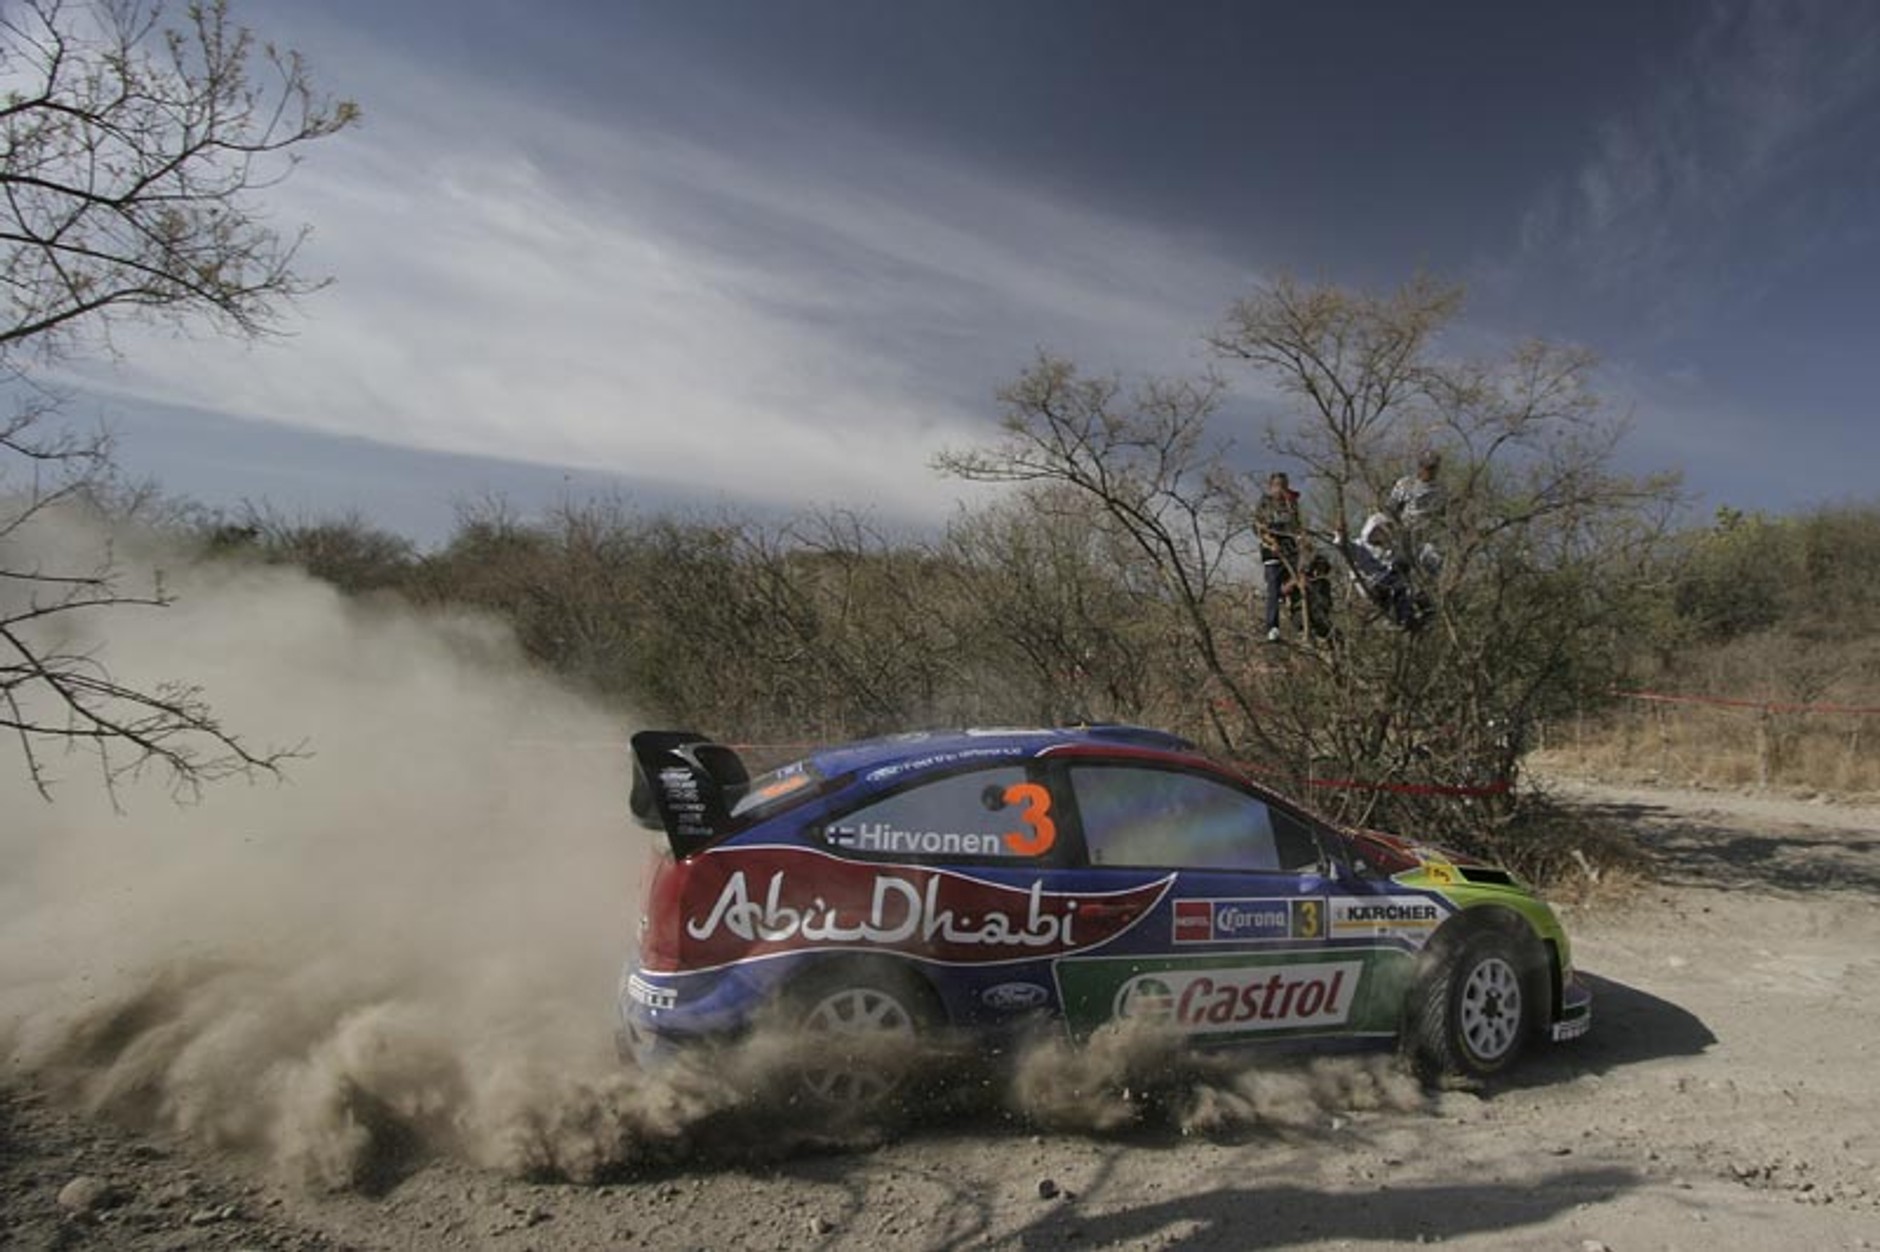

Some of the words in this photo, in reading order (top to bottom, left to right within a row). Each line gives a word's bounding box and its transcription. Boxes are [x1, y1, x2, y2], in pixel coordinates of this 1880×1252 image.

[860, 823, 999, 853] Hirvonen
[1003, 783, 1056, 856] 3
[687, 871, 864, 941] Abu
[864, 874, 1077, 945] Dhabi
[1217, 907, 1285, 932] Corona
[1302, 902, 1317, 936] 3
[1177, 970, 1345, 1026] Castrol
